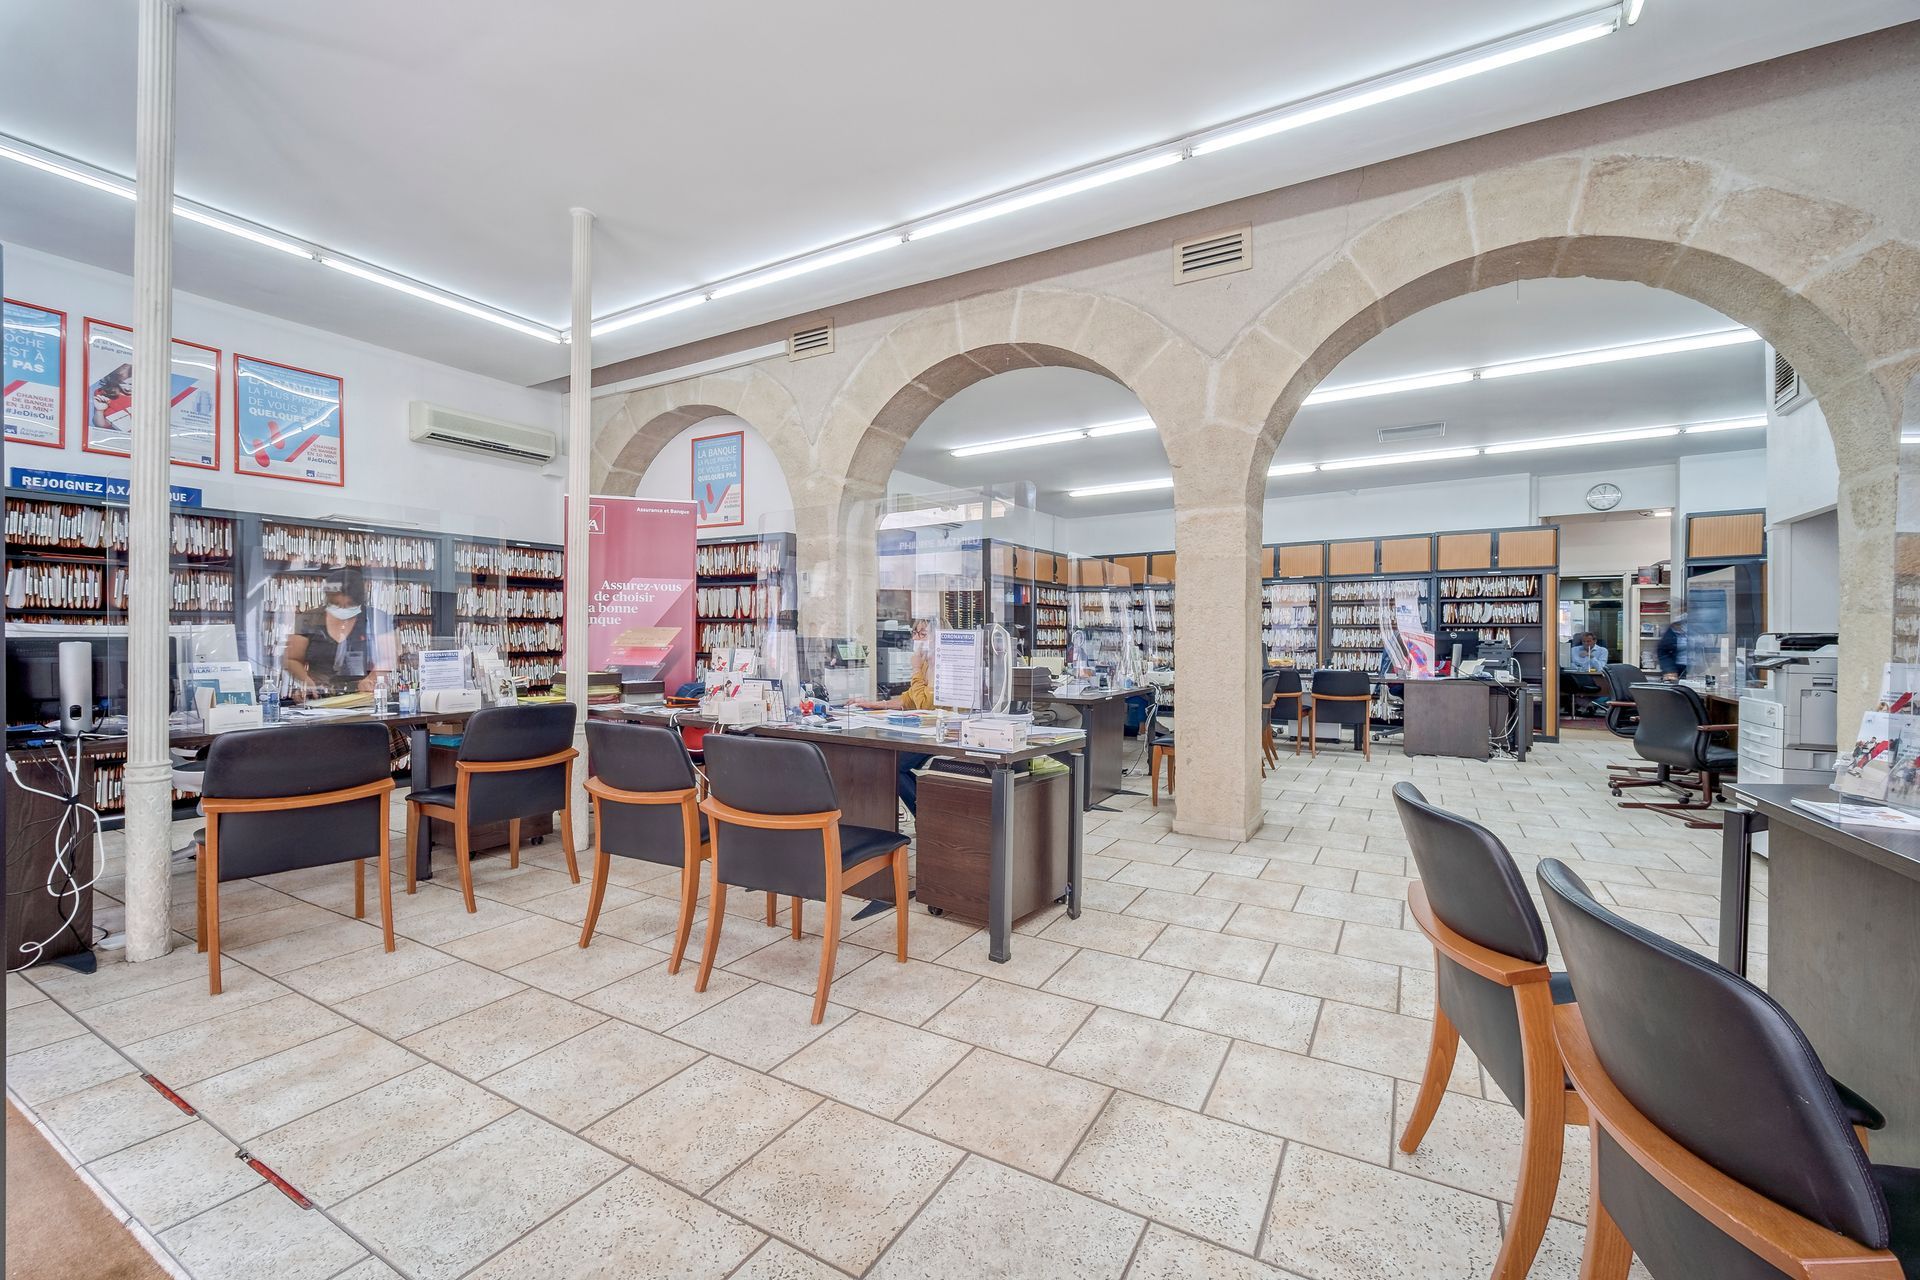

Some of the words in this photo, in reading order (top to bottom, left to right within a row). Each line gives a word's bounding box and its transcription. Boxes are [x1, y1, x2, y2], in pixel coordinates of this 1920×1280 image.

[12, 359, 45, 374] PAS
[248, 386, 261, 395] LA
[263, 390, 290, 401] PLUS
[248, 396, 265, 408] DE
[267, 400, 299, 414] VOUS
[6, 407, 55, 421] #JeDisOui
[248, 407, 308, 424] QUELQUES
[697, 450, 707, 459] LA
[708, 445, 737, 457] BANQUE
[21, 475, 103, 493] REJOIGNEZ
[601, 580, 683, 592] Assurez-vous
[594, 591, 610, 602] de
[612, 592, 656, 602] choisir
[598, 602, 639, 614] bonne
[941, 633, 975, 641] CORONAVIRUS
[424, 651, 459, 659] CORONAVIRUS
